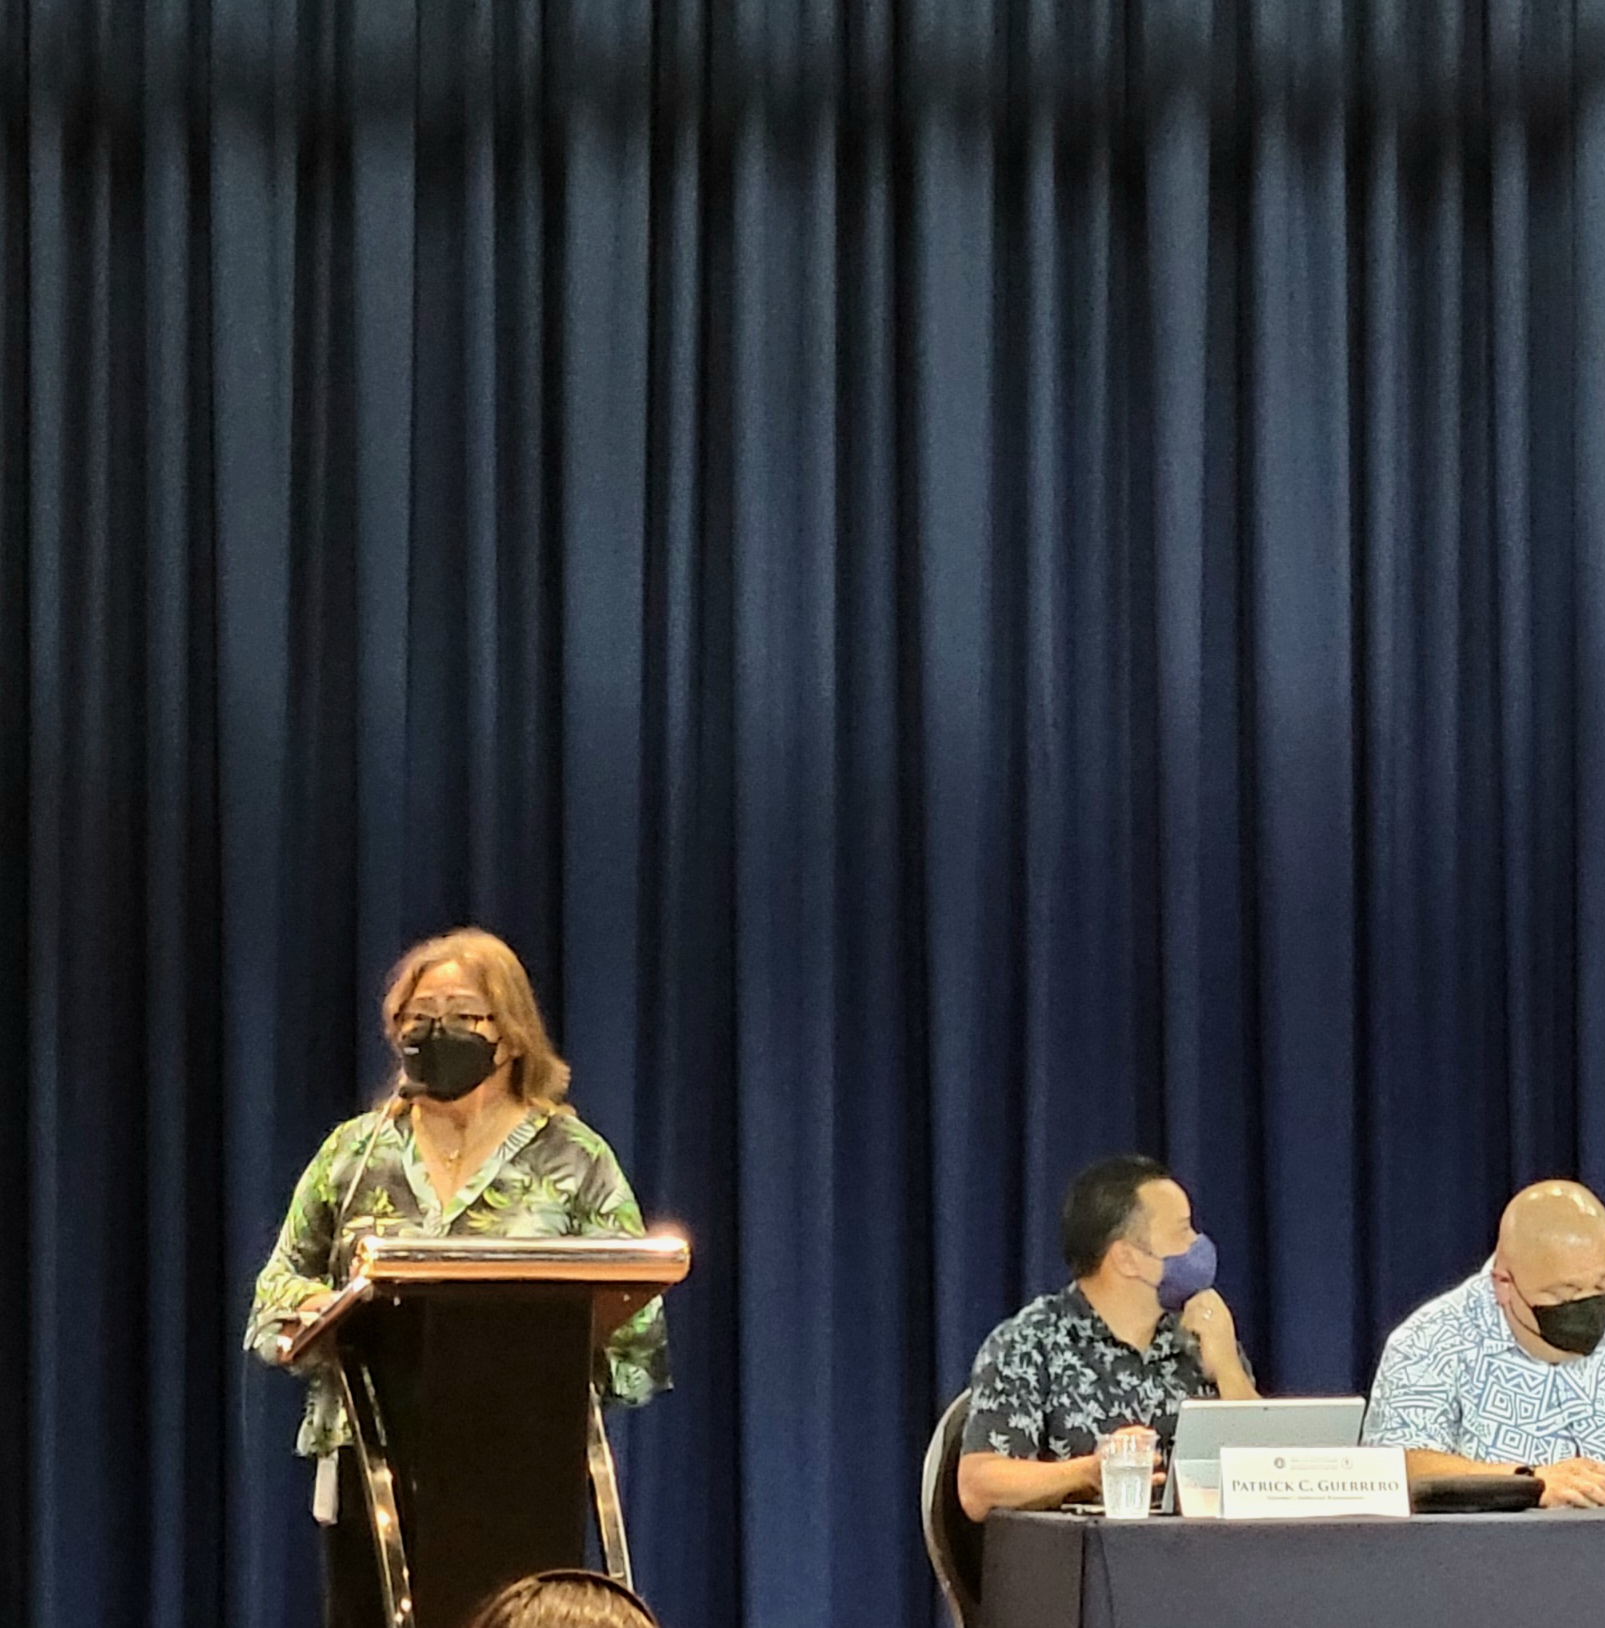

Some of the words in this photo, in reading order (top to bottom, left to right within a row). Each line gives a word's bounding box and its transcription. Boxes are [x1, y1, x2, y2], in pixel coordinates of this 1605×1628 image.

[1231, 1480, 1295, 1492] PATRICK
[1299, 1480, 1313, 1492] C.
[1318, 1480, 1399, 1492] GUERRERO
